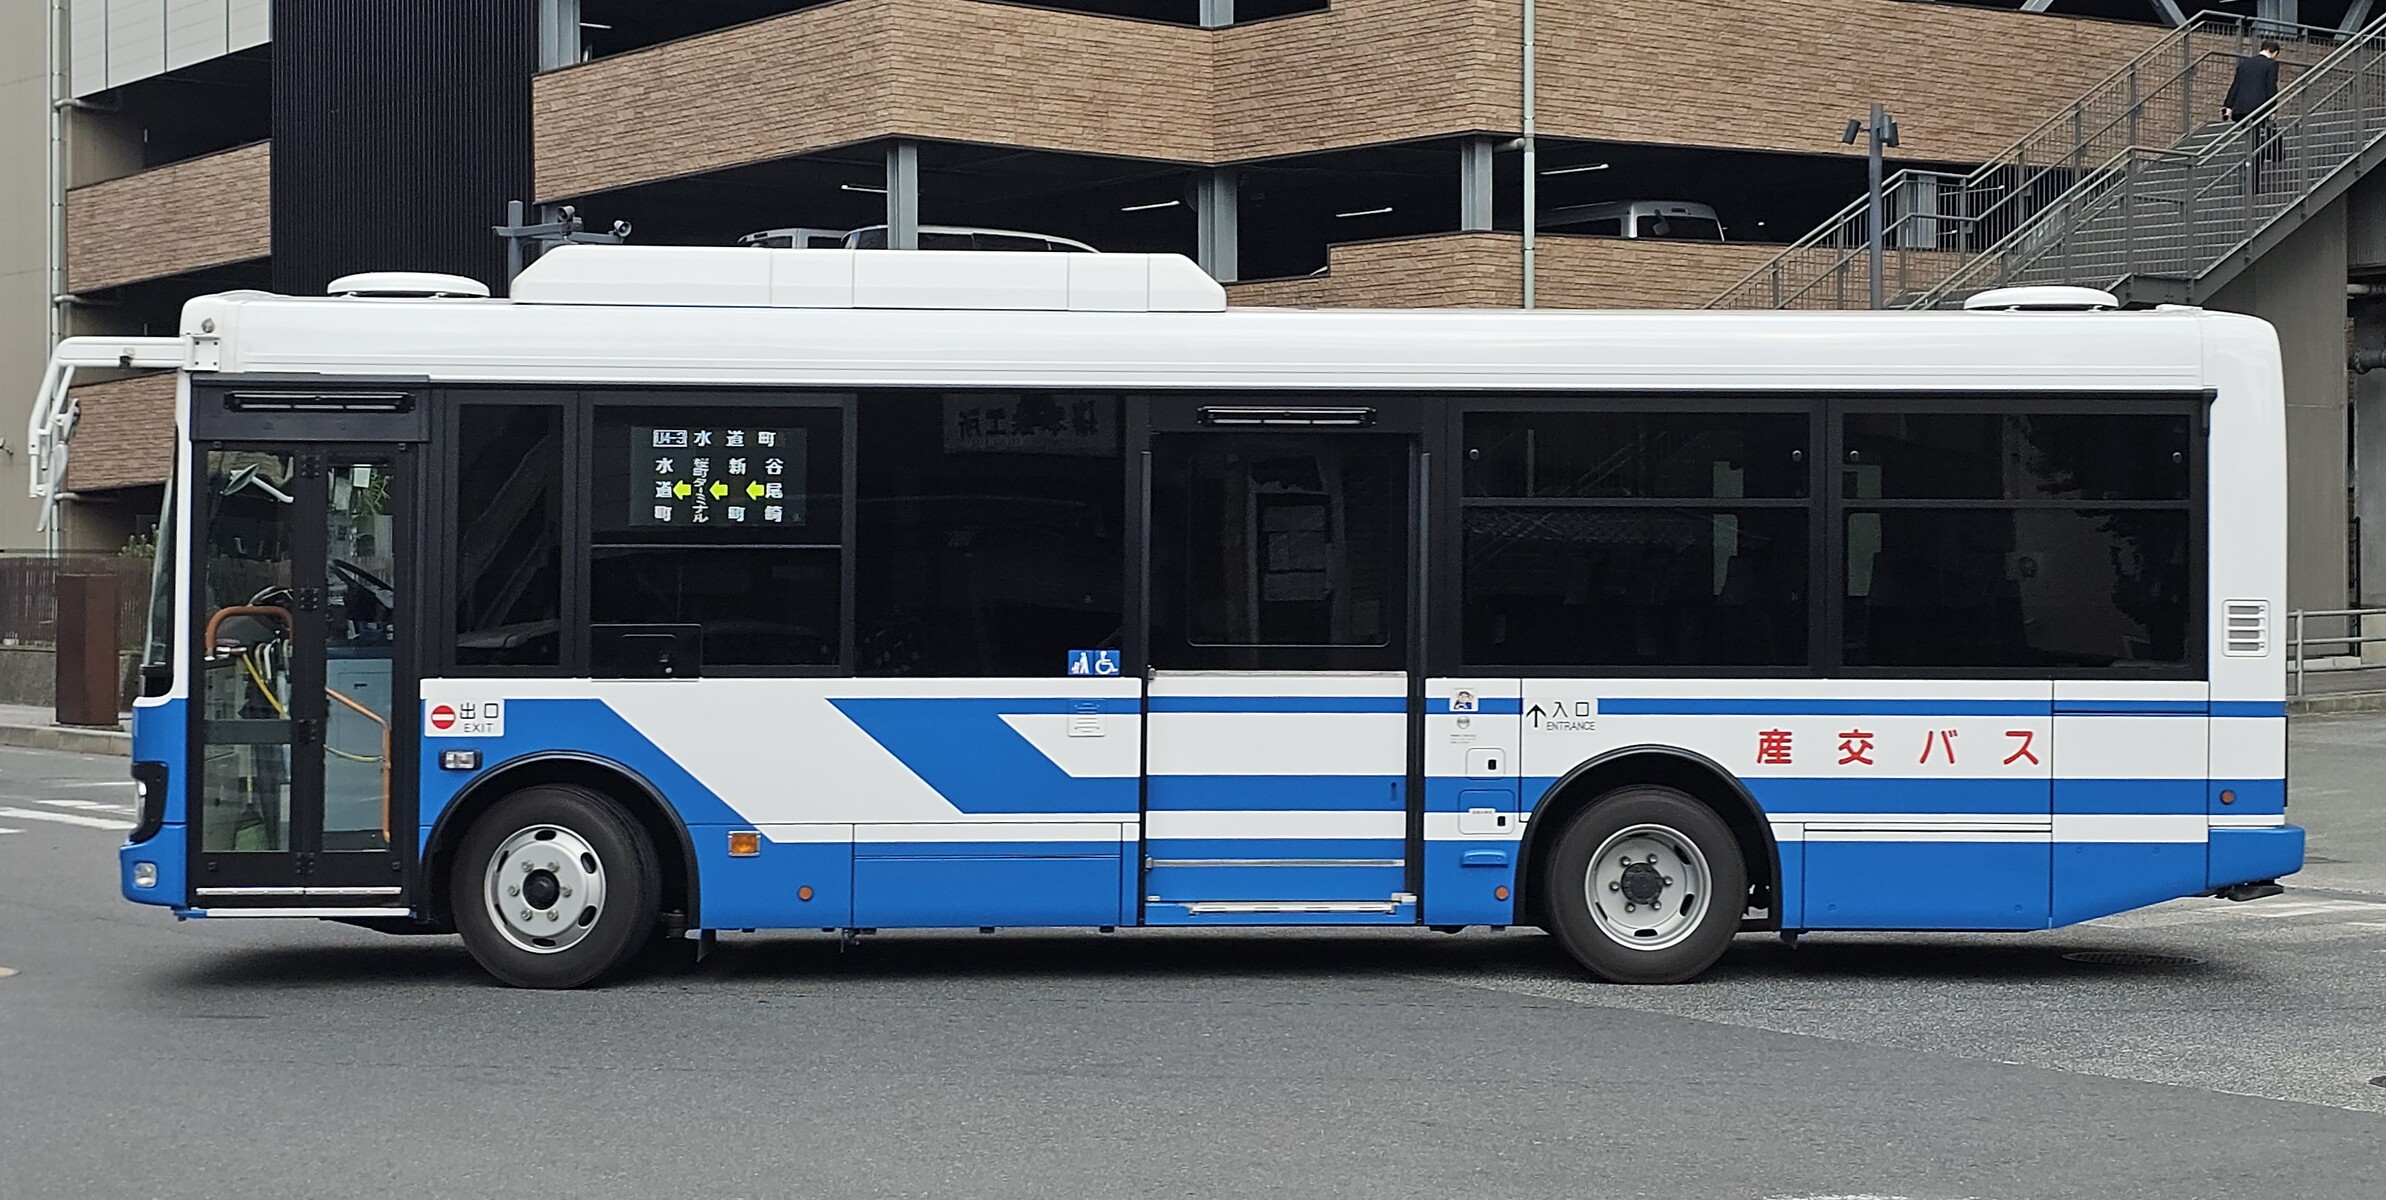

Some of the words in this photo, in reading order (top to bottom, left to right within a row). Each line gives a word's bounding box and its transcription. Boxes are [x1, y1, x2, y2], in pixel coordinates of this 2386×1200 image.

[693, 430, 777, 447] 水道町
[654, 457, 674, 522] 水道町
[728, 457, 747, 522] 新町
[764, 458, 784, 522] 谷尾崎
[460, 702, 499, 719] 出口
[1553, 701, 1589, 717] 入口
[464, 723, 494, 733] EXIT
[1546, 721, 1596, 731] ENTRANCE
[1757, 728, 2039, 765] 産交バス
